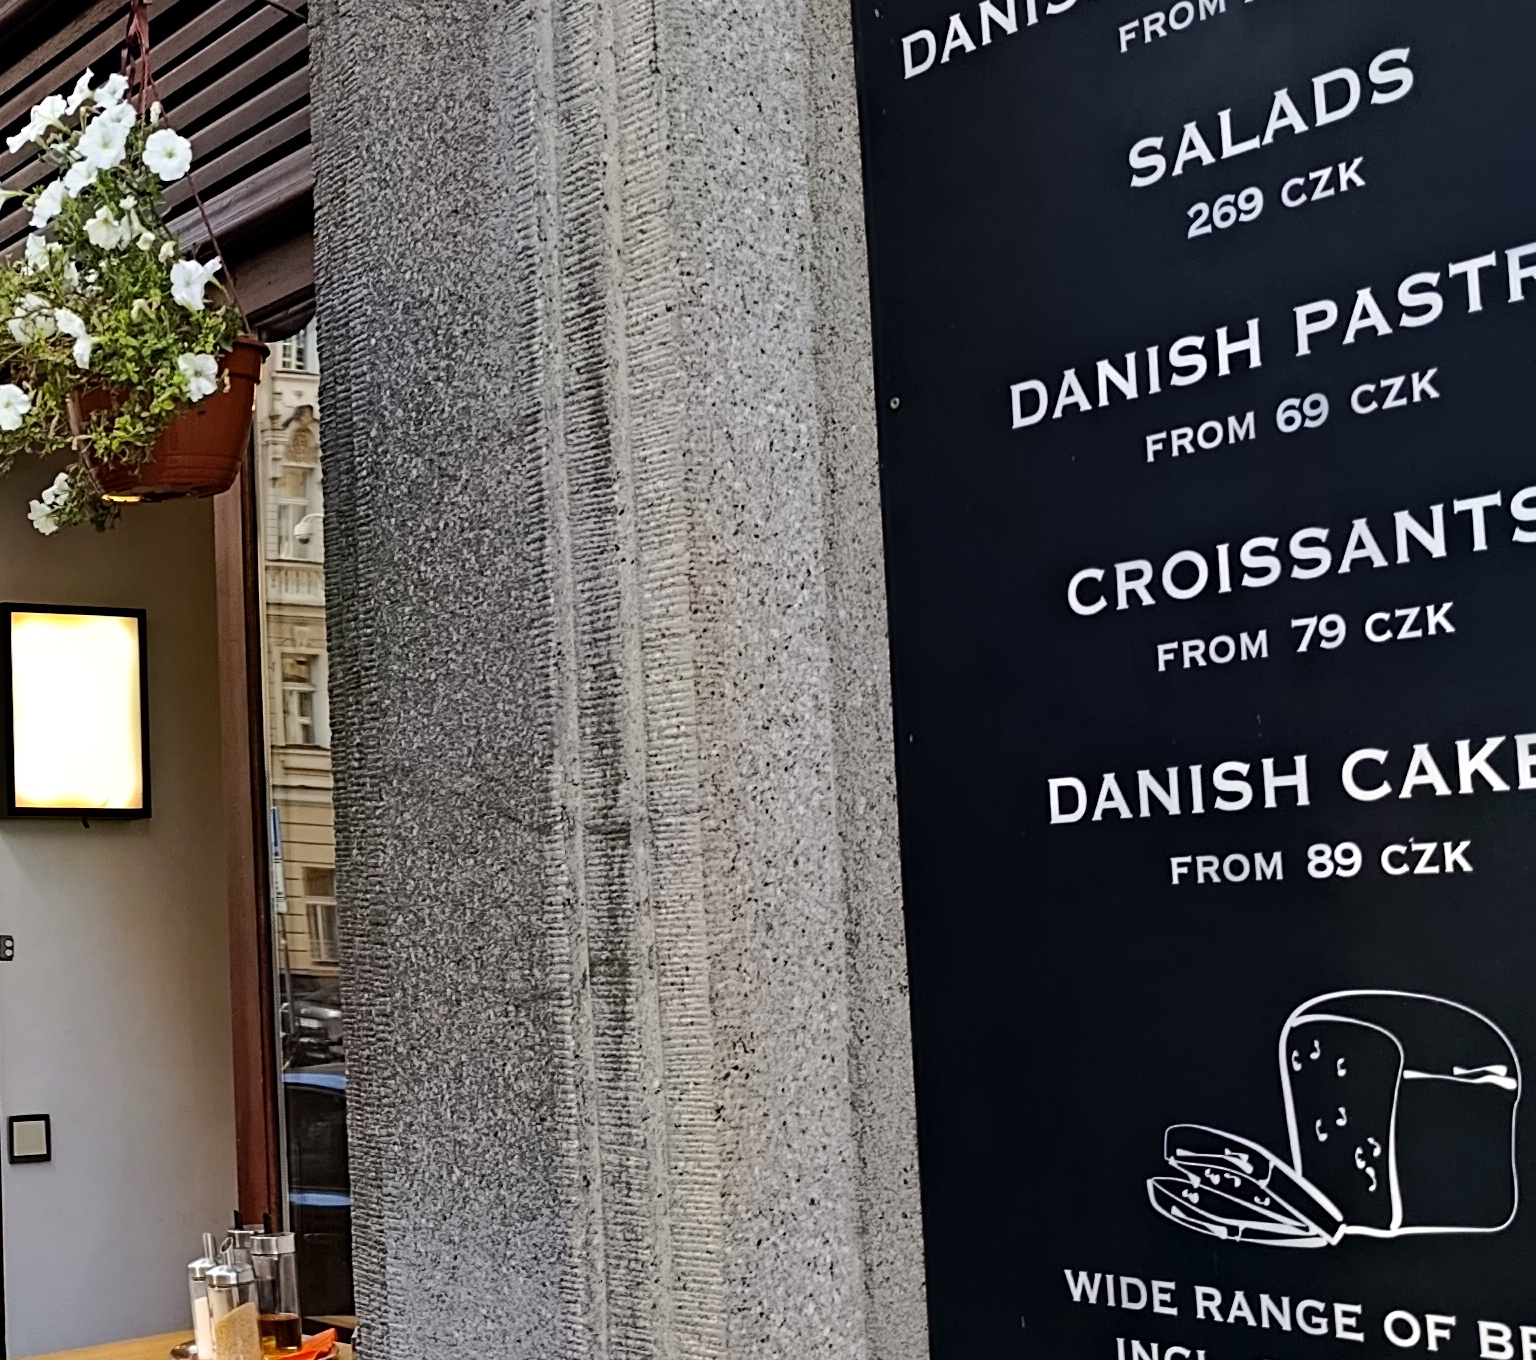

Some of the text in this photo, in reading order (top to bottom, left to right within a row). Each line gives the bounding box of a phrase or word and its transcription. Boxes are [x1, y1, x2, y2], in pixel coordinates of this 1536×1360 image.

[1128, 47, 1415, 189] SALADS
[1186, 156, 1366, 240] 269 CZK
[1009, 317, 1263, 430] DANISH
[1145, 367, 1441, 463] FROM 69 CZK
[1067, 485, 1536, 616] CROISSANTS
[1156, 601, 1457, 672] FROM 79 CZK
[1047, 754, 1311, 825] DANISH
[1170, 840, 1475, 885] FROM 89 CZK
[1064, 1269, 1179, 1317] WIDE
[1194, 1285, 1365, 1344] RANGE
[1383, 1310, 1457, 1353] OF
